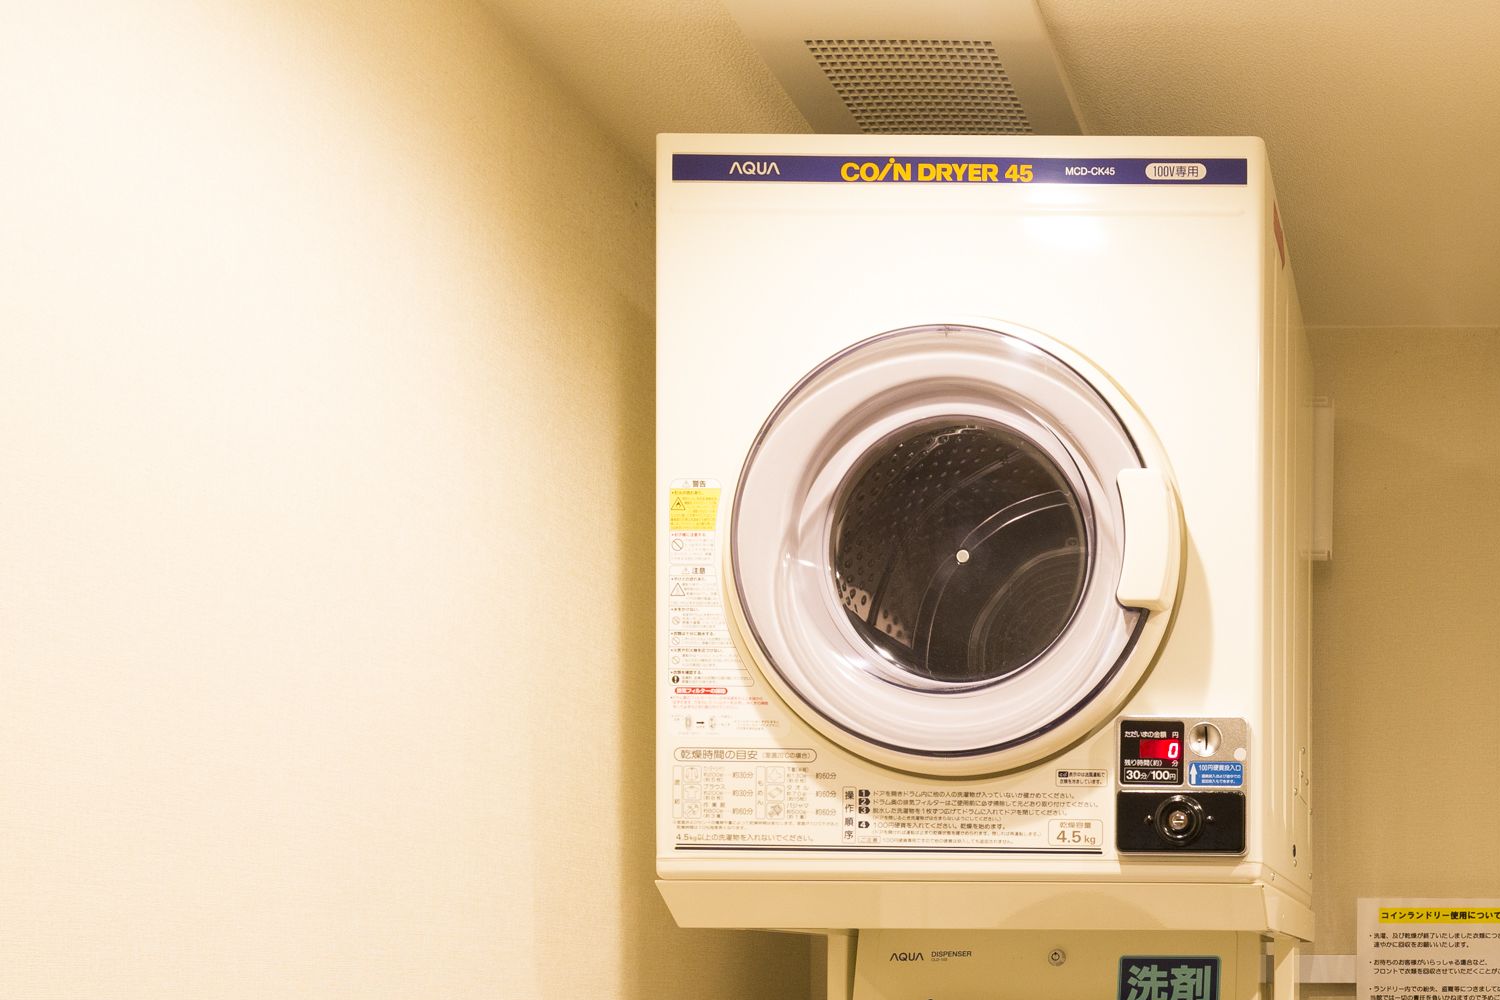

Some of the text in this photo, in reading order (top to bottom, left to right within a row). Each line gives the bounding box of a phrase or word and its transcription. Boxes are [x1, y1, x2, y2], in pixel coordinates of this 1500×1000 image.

[729, 162, 780, 176] AQUA
[918, 164, 998, 182] DRYER
[1004, 164, 1033, 182] 45
[1065, 167, 1115, 176] MCD-CK45
[1153, 166, 1199, 177] 100V専用
[1172, 731, 1179, 739] 円
[681, 750, 758, 760] 乾燥時間の目安
[1168, 743, 1179, 758] 0
[1126, 770, 1176, 780] 30分/100円
[845, 791, 854, 839] 操作順序
[1056, 831, 1096, 845] 4.5 kg
[889, 952, 924, 962] AQUA
[931, 950, 972, 958] DISPENSER
